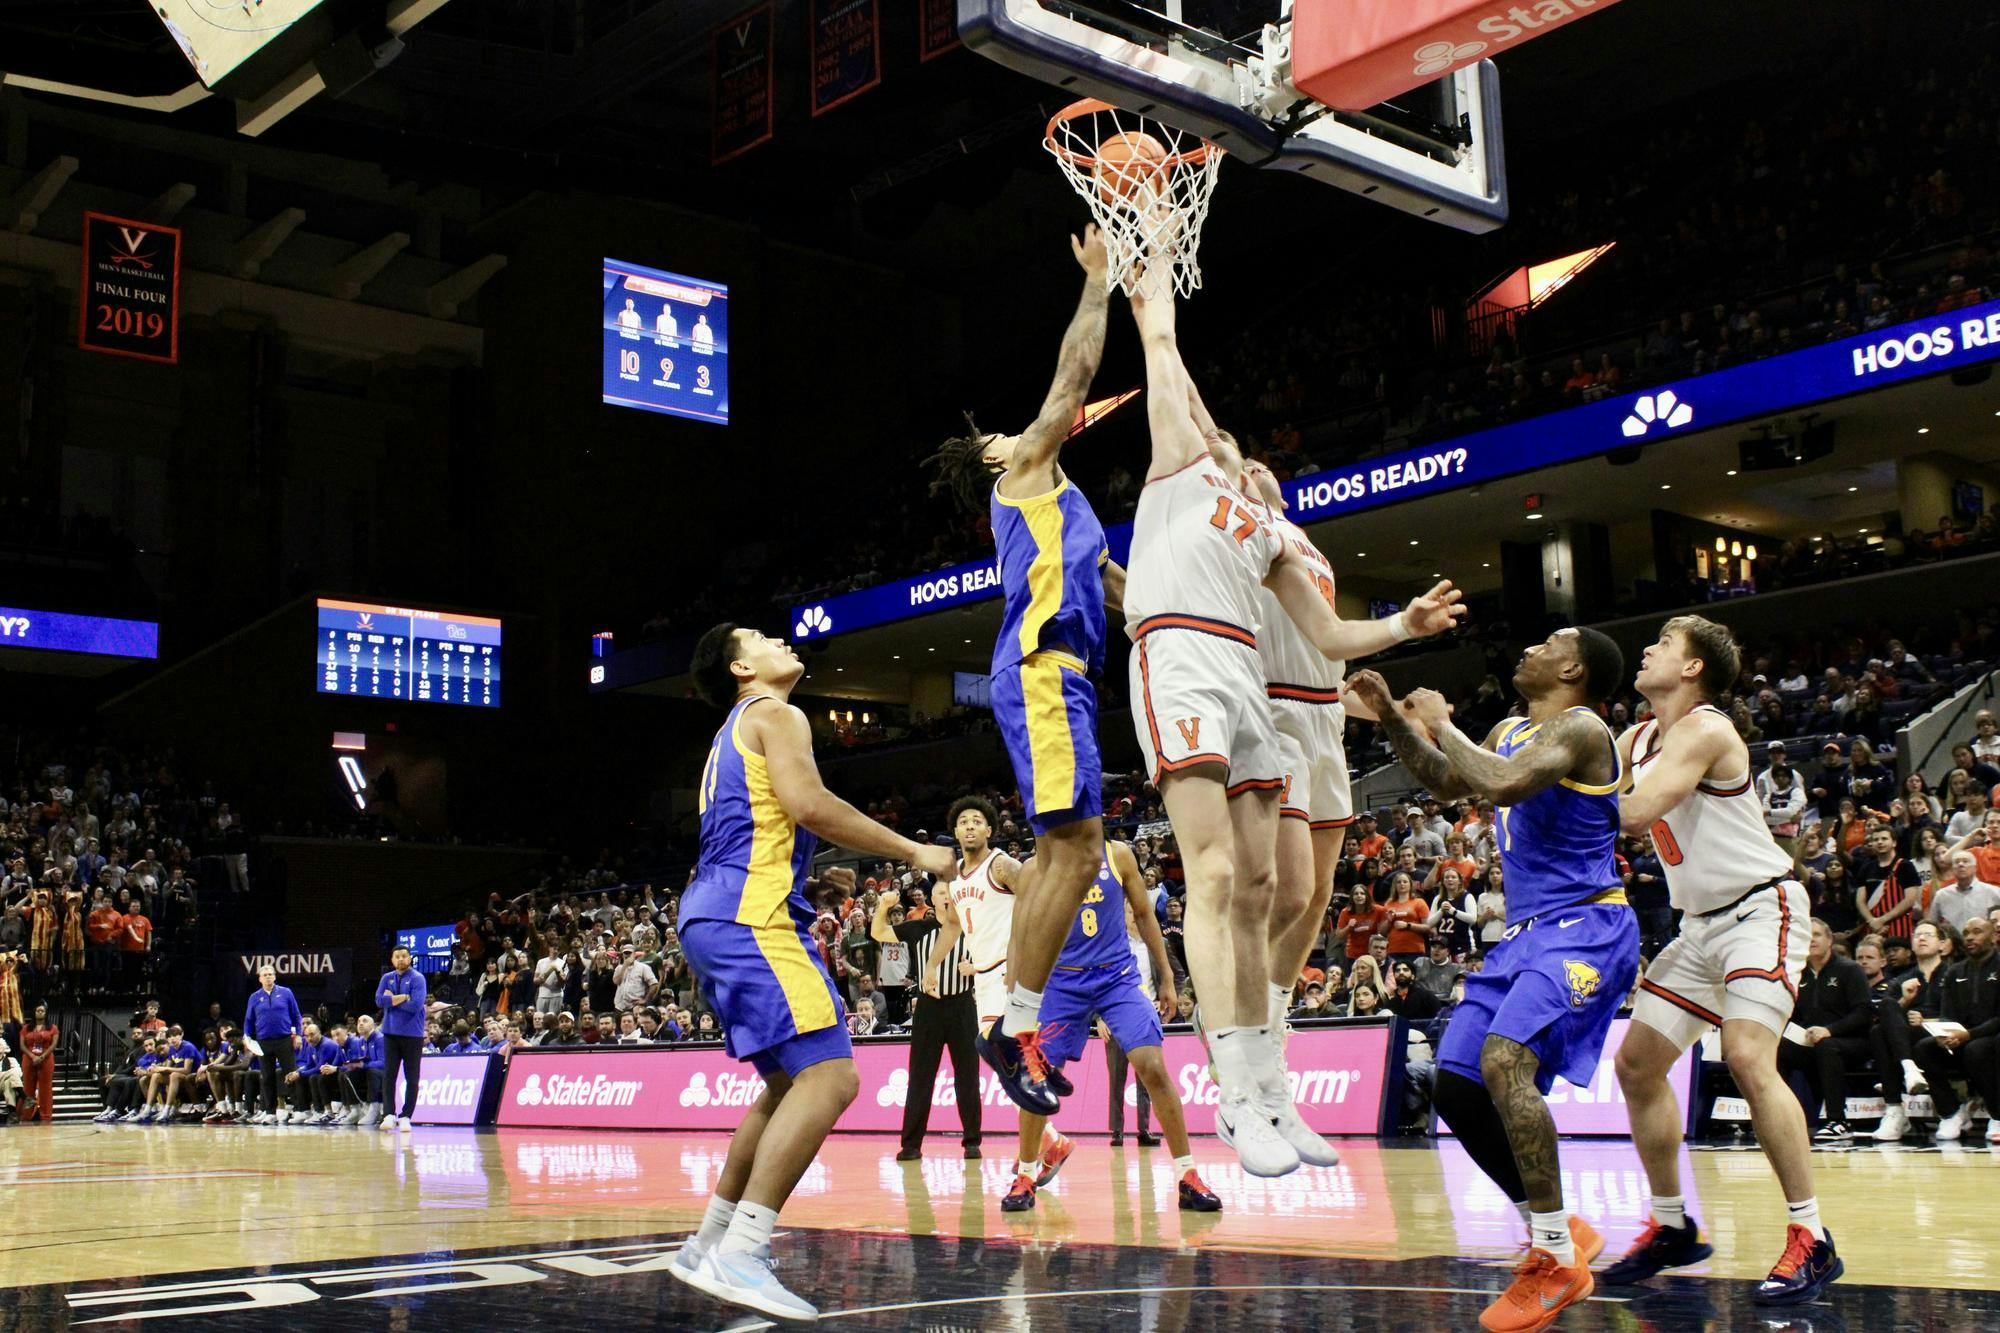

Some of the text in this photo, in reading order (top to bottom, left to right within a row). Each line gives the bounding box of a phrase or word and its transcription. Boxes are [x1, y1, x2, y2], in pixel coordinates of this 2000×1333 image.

[121, 266, 166, 281] BASKETBALL
[95, 282, 167, 304] FINAL FOUR
[96, 304, 164, 339] 2019
[1853, 326, 1954, 376] HOOS
[621, 349, 640, 375] 10
[660, 358, 674, 381] 9
[697, 365, 710, 388] 3
[1297, 474, 1366, 512] HOOS
[1370, 448, 1467, 494] READY?
[1210, 495, 1257, 546] 17
[910, 575, 958, 606] HOOS
[347, 633, 362, 642] PTS
[392, 638, 403, 646] PF
[439, 642, 453, 651] PTS
[326, 662, 338, 670] 17
[351, 664, 357, 672] 3
[373, 666, 379, 674] 1
[422, 661, 428, 669] 7
[464, 656, 470, 664] 2
[351, 674, 357, 682] 7
[373, 676, 379, 684] 9
[394, 678, 400, 686] 0
[443, 673, 449, 681] 2
[464, 675, 469, 683] 3
[484, 677, 490, 685] 0
[350, 684, 357, 692] 2
[394, 688, 400, 696] 0
[443, 683, 449, 691] 3
[484, 687, 490, 695] 1
[483, 696, 490, 704] 0
[1176, 716, 1201, 751] V
[966, 907, 973, 935] 1
[1080, 908, 1099, 938] 8
[1439, 918, 1455, 933] 22
[241, 953, 335, 975] VIRGINIA
[887, 950, 900, 961] 33
